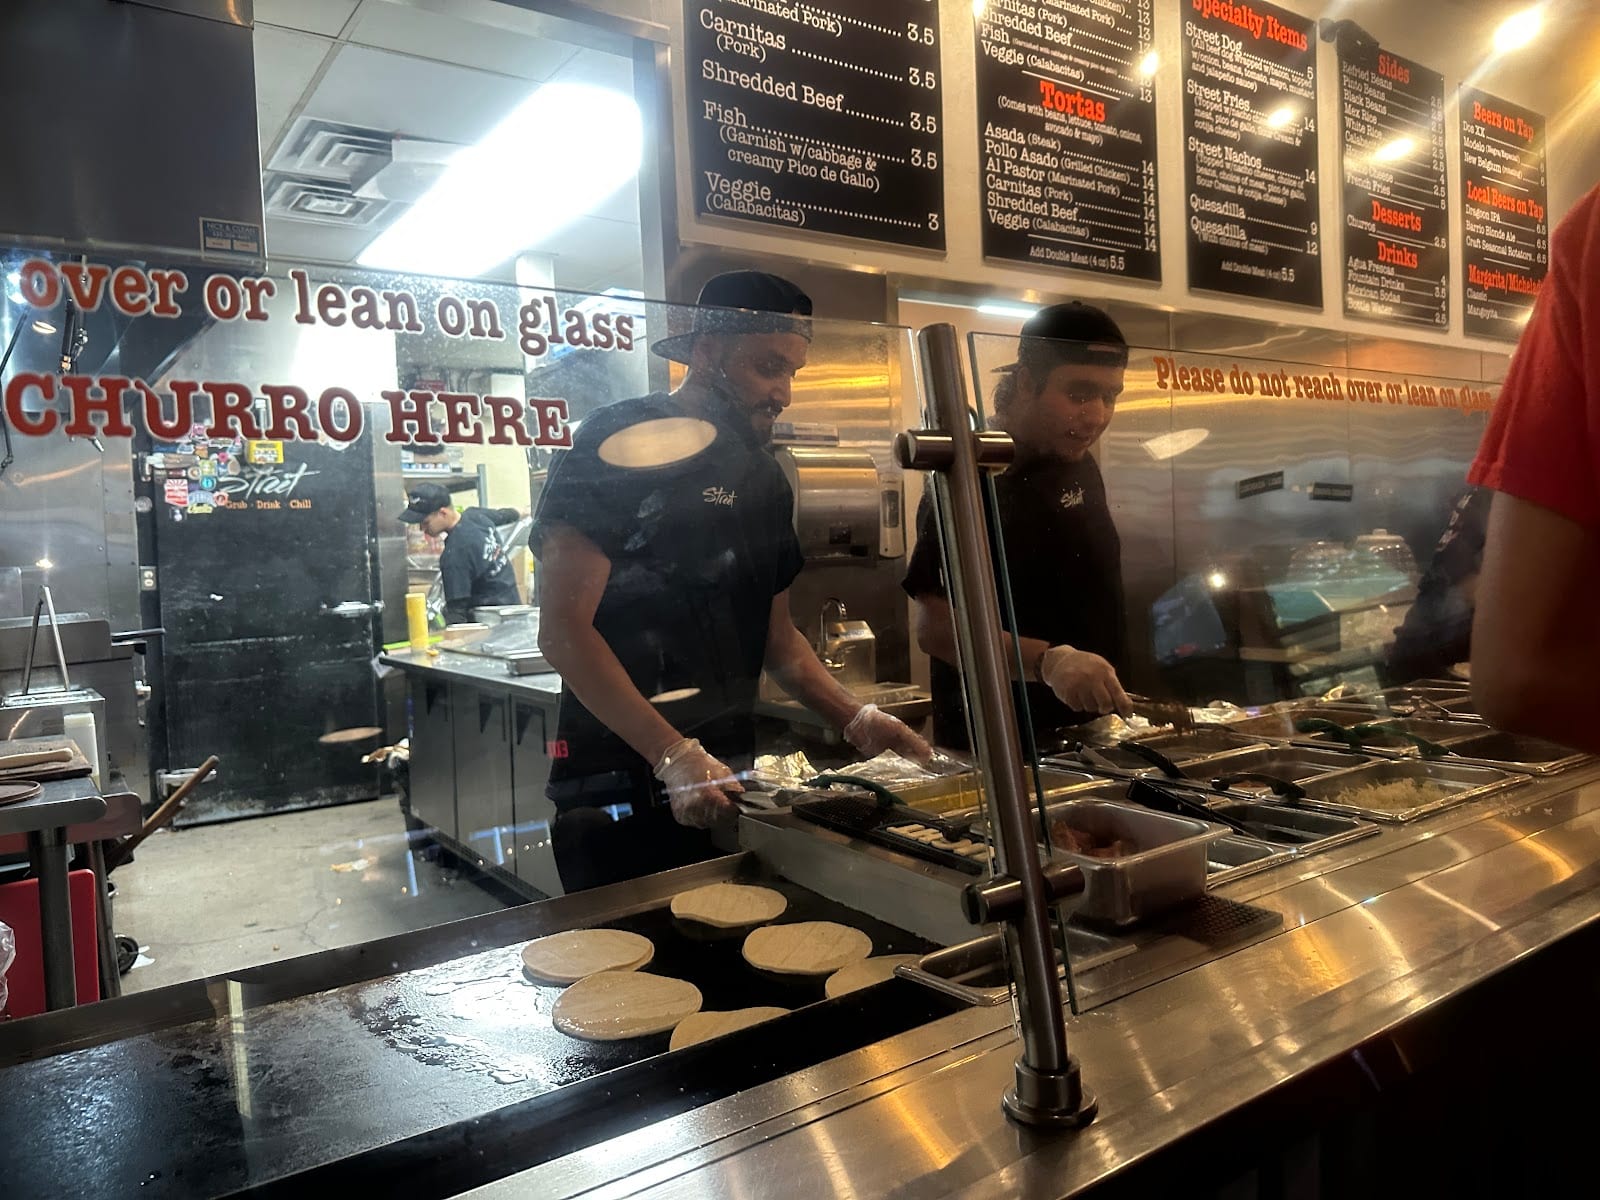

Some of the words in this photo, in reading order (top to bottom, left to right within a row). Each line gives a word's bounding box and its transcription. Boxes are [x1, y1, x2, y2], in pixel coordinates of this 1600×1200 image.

[719, 0, 799, 22] arinated
[802, 10, 842, 37] Pork)
[907, 23, 934, 45] 3.5
[981, 22, 1010, 44] Fish
[982, 0, 1035, 18] rnitas
[1038, 8, 1068, 28] (Pork)
[982, 7, 1042, 38] Shredded
[1044, 25, 1072, 47] Beef
[1138, 10, 1150, 25] 13
[1138, 25, 1151, 40] 13
[1192, 0, 1264, 40] Specialty
[1266, 15, 1308, 52] Items
[700, 8, 786, 50] Carnitas
[909, 67, 936, 89] 3.5
[716, 34, 767, 63] (Pork)
[1185, 21, 1220, 46] Street
[1221, 34, 1242, 58] Dog
[981, 40, 1024, 65] Veggie
[1026, 53, 1085, 82] (Calabacitas)
[1140, 87, 1152, 103] 13
[1378, 54, 1410, 84] Sides
[702, 59, 798, 101] Shredded
[801, 85, 844, 112] Beef
[910, 112, 937, 134] 3.5
[998, 95, 1026, 113] (Comes
[1028, 103, 1043, 117] with
[1039, 80, 1105, 122] Tortas
[1187, 78, 1221, 102] Street
[1222, 91, 1250, 112] Fries
[1304, 117, 1315, 132] 14
[703, 100, 748, 128] Fish
[911, 148, 937, 170] 3.5
[1473, 101, 1502, 128] Beers
[1504, 116, 1516, 133] on
[1517, 118, 1534, 144] Tap
[719, 124, 786, 153] (Garnish
[790, 142, 862, 172] w/cabbage
[865, 158, 877, 171] &
[984, 121, 1025, 145] Asada
[1028, 132, 1061, 152] (Steak)
[1142, 160, 1154, 176] 14
[985, 139, 1017, 159] Pollo
[1020, 148, 1059, 168] Asado
[1060, 157, 1093, 174] (Grilled
[1094, 165, 1131, 184] Chicken)
[1142, 176, 1154, 191] 14
[1188, 136, 1222, 158] Street
[1224, 147, 1262, 169] Nachos
[1305, 169, 1316, 184] 14
[727, 148, 784, 173] creamy
[787, 158, 816, 178] Pico
[820, 165, 837, 182] de
[840, 169, 880, 193] Gallo)
[986, 157, 1000, 172] Al
[1004, 160, 1046, 182] Pastor
[1048, 170, 1096, 192] (Marinated
[1098, 181, 1120, 198] Pork)
[1143, 191, 1155, 206] 14
[704, 171, 771, 201] Veggie
[928, 214, 939, 231] 3
[705, 192, 806, 226] (Calabacitas)
[986, 173, 1041, 198] Carnitas
[1044, 185, 1073, 204] (Pork)
[1143, 207, 1156, 221] 14
[987, 191, 1048, 216] Shredded
[1051, 202, 1079, 221] Beef
[1144, 222, 1156, 237] 14
[1190, 193, 1246, 219] Quesadilla
[1311, 222, 1317, 235] 9
[1372, 200, 1422, 232] Desserts
[1467, 180, 1490, 204] Local
[1492, 186, 1516, 213] Beers
[1517, 199, 1527, 215] on
[1528, 199, 1544, 222] Tap
[988, 208, 1030, 231] Veggie
[1032, 217, 1090, 238] (Calabacitas)
[1144, 238, 1157, 252] 14
[1191, 215, 1247, 240] Quesadilla
[1306, 240, 1318, 256] 12
[1030, 245, 1044, 258] Add
[1045, 248, 1070, 262] Double
[1110, 255, 1125, 271] 5.5
[1378, 240, 1418, 269] Drinks
[1468, 264, 1543, 296] Margarita/Michelad
[19, 258, 187, 319] over
[204, 272, 275, 322] or
[290, 269, 425, 334] lean
[437, 294, 504, 342] on
[518, 295, 635, 357] glass
[1153, 355, 1226, 394] Please
[1229, 364, 1254, 396] do
[1256, 367, 1292, 398] not
[1294, 371, 1344, 401] reach
[1346, 378, 1383, 404] over
[1386, 381, 1403, 404] or
[1404, 379, 1438, 408] lean
[1440, 386, 1458, 409] on
[2, 369, 364, 444] CHURRO
[383, 389, 574, 448] HERE
[226, 499, 247, 509] Grub
[257, 499, 281, 509] Drink
[290, 499, 312, 509] Chill
